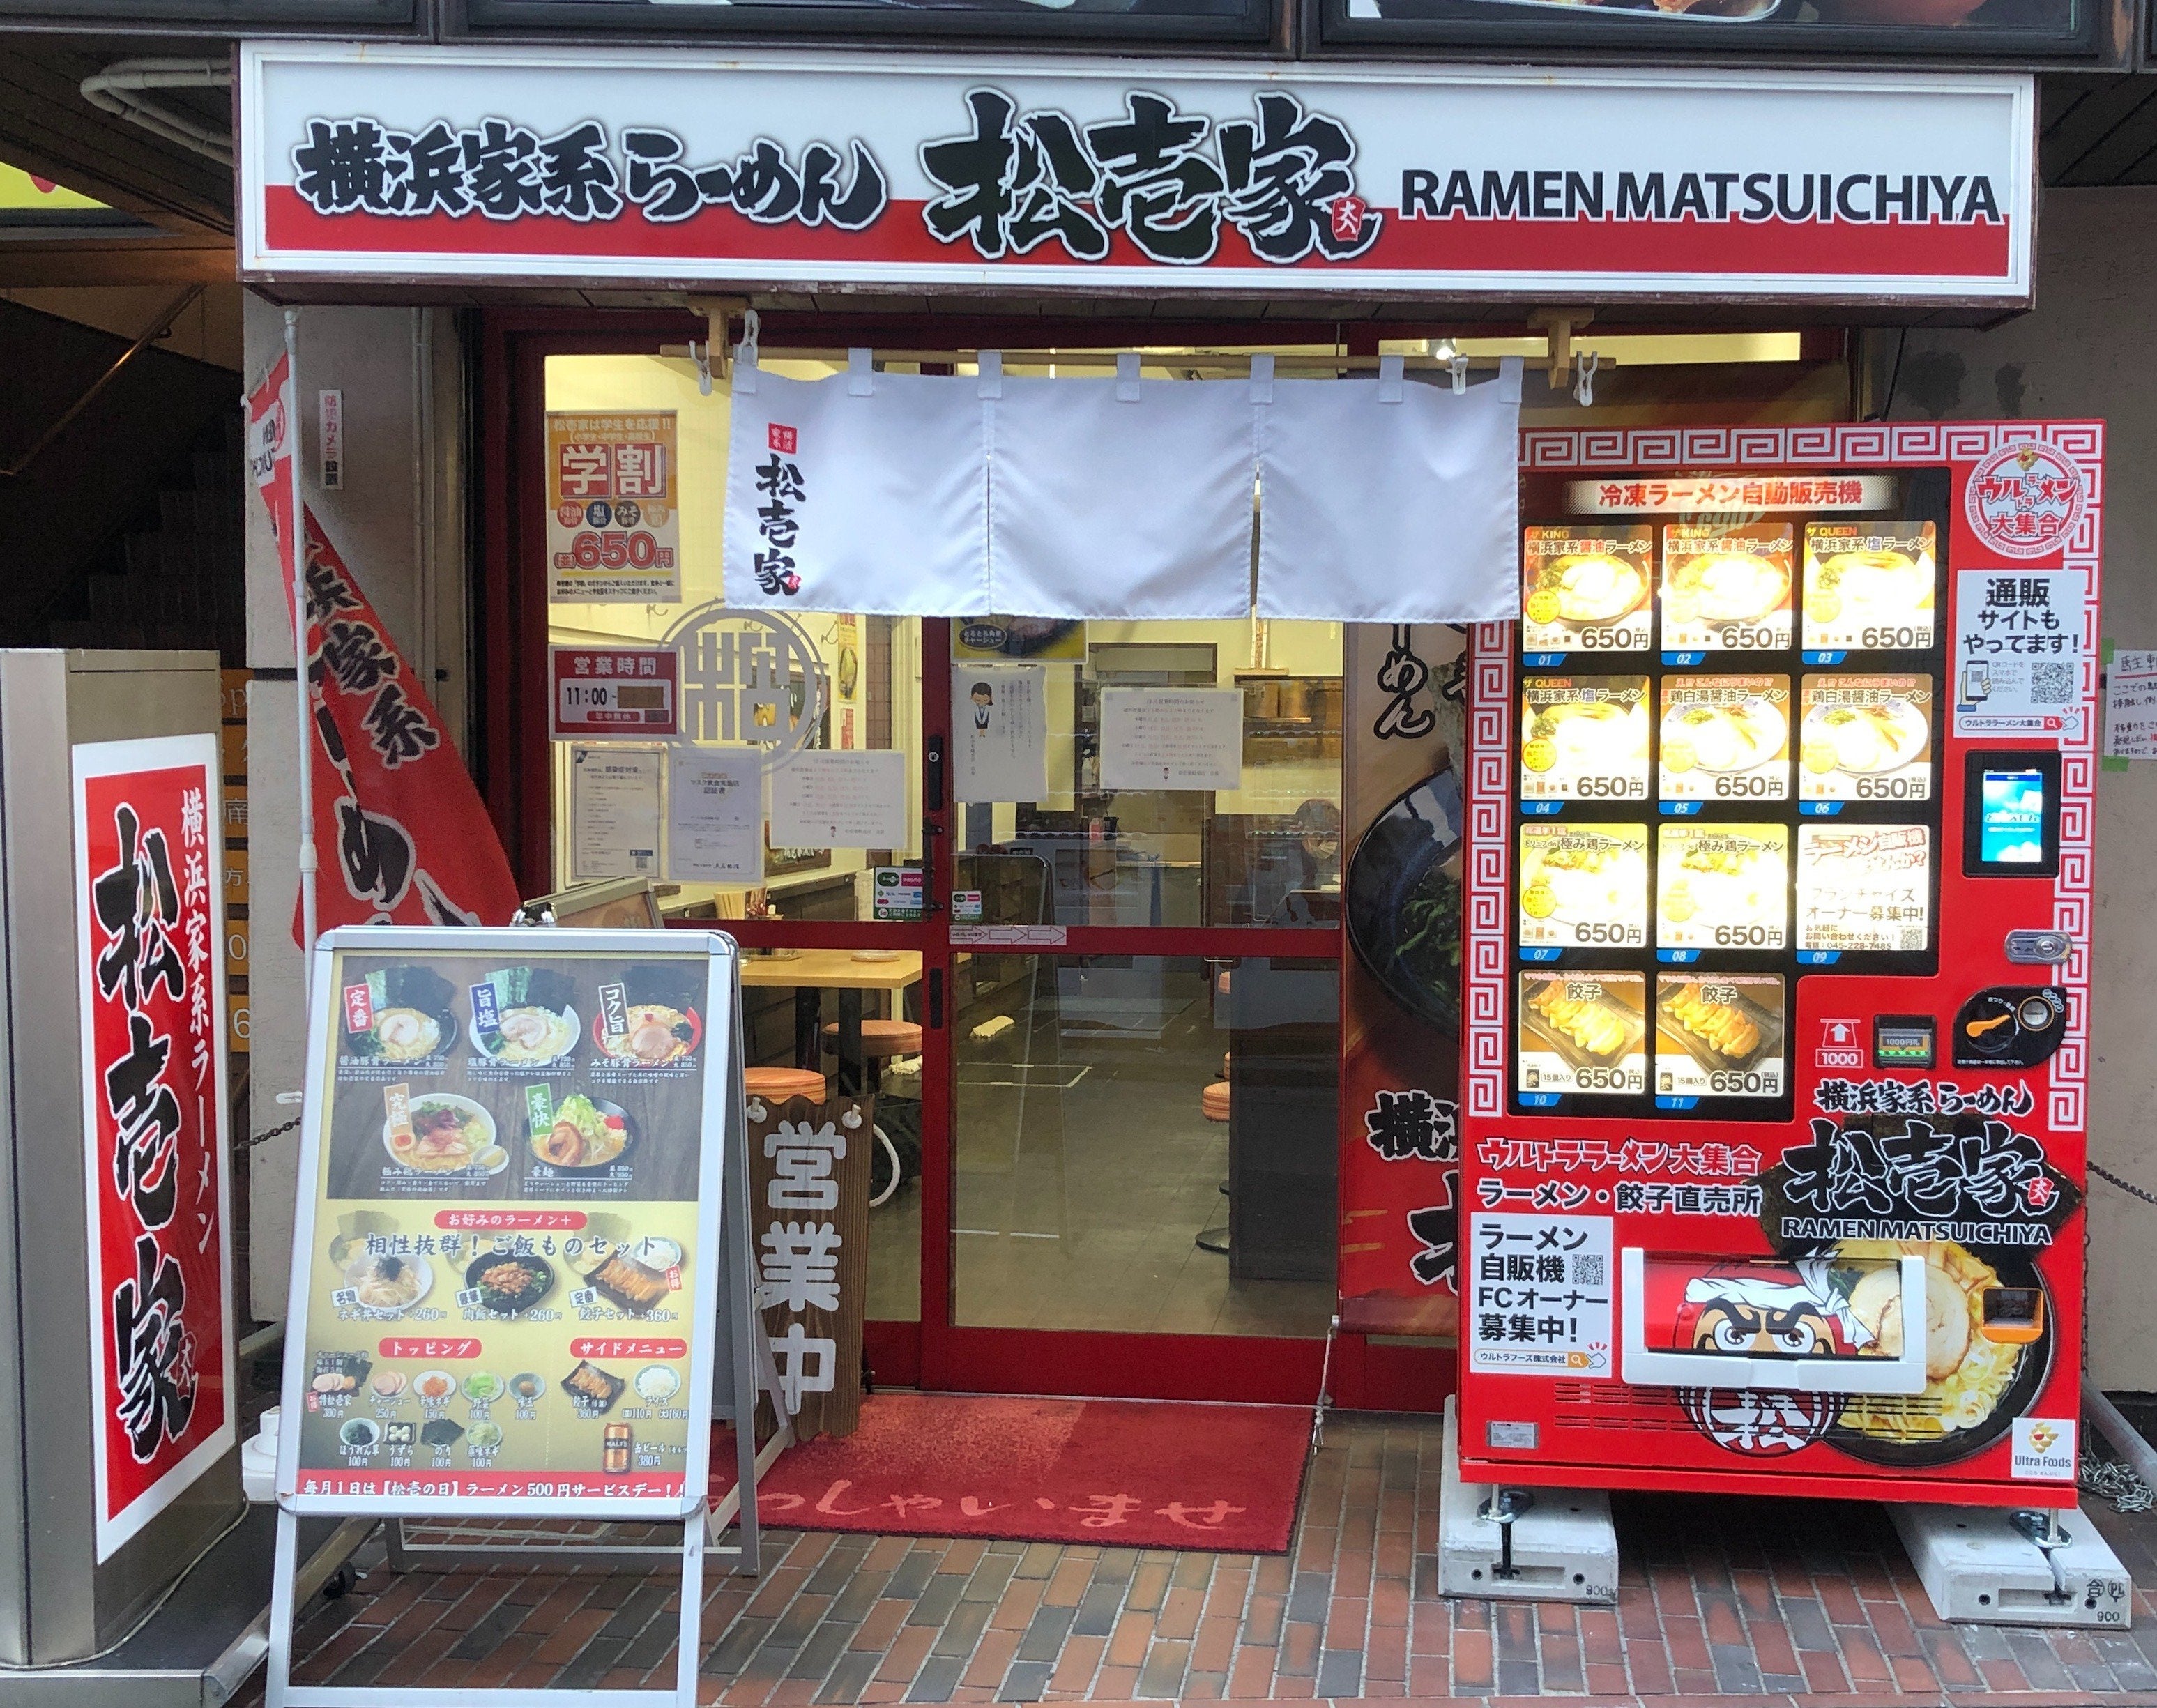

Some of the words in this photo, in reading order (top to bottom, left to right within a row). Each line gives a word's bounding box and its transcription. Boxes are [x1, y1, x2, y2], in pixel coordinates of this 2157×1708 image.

[292, 117, 887, 230] 横浜家系らーめん
[920, 86, 1383, 264] 松壱家
[1613, 169, 2005, 225] MATSUICHIYA
[562, 445, 662, 495] 学割
[1599, 480, 1863, 508] 冷凍ラーメン自動販売機
[754, 453, 807, 596] 松壱家
[1819, 526, 1858, 537] QUEEN
[1991, 511, 2060, 537] 大集合
[1986, 578, 2050, 607] 通販
[1977, 609, 2060, 630] サイトも
[1962, 633, 2080, 655] やってます!
[573, 656, 657, 676] 営業時間
[1538, 655, 1553, 667] 01
[1676, 653, 1692, 666] 02
[1817, 651, 1834, 665] 03
[1535, 678, 1573, 689] QUEEN
[1965, 719, 2041, 728] ウルトララーメン大集合
[1535, 802, 1550, 814] 04
[1673, 802, 1689, 814] 05
[1814, 802, 1830, 814] 06
[1806, 906, 1924, 922] オーナー募集中!
[1533, 949, 1549, 960] 07
[1672, 950, 1688, 961] 08
[1813, 953, 1828, 963] 09
[1565, 982, 1603, 1001] 餃子
[1700, 985, 1738, 1005] 餃子
[349, 989, 369, 1028] 定番
[475, 989, 499, 1028] 旨塩
[605, 989, 625, 1033] コク旨
[180, 786, 213, 1254] 横浜家系ラーメン
[1821, 1051, 1858, 1066] 1000
[1814, 1078, 2035, 1117] 横浜家系らーめん
[388, 1092, 408, 1128] 究極
[531, 1092, 550, 1128] 豪快
[92, 801, 199, 1464] 松壱家
[1477, 1137, 1764, 1177] ウルトララーメン大集合
[1781, 1117, 2060, 1217] 松壱家
[1479, 1180, 1763, 1216] ラーメン・餃子直売所
[1479, 1223, 1589, 1251] ラーメン
[1782, 1217, 1879, 1240] RAMEN
[1880, 1220, 2052, 1246] MATSUICHIYA
[761, 1120, 847, 1416] 営業中
[1479, 1253, 1565, 1283] 自販機
[579, 1307, 636, 1320] 餃子セット
[1478, 1312, 1578, 1343] 募集中!
[393, 1341, 472, 1357] トッピング
[579, 1341, 683, 1355] サイドメニュー
[1480, 1352, 1567, 1364] ウルトラフーズ株式会社
[369, 1396, 411, 1405] チャーシュー
[645, 1396, 669, 1406] ライス
[389, 1446, 414, 1456] うずら
[434, 1446, 451, 1456] のり
[2015, 1455, 2041, 1467] Ultra
[2043, 1456, 2072, 1468] Foods
[2097, 1611, 2121, 1623] 900
